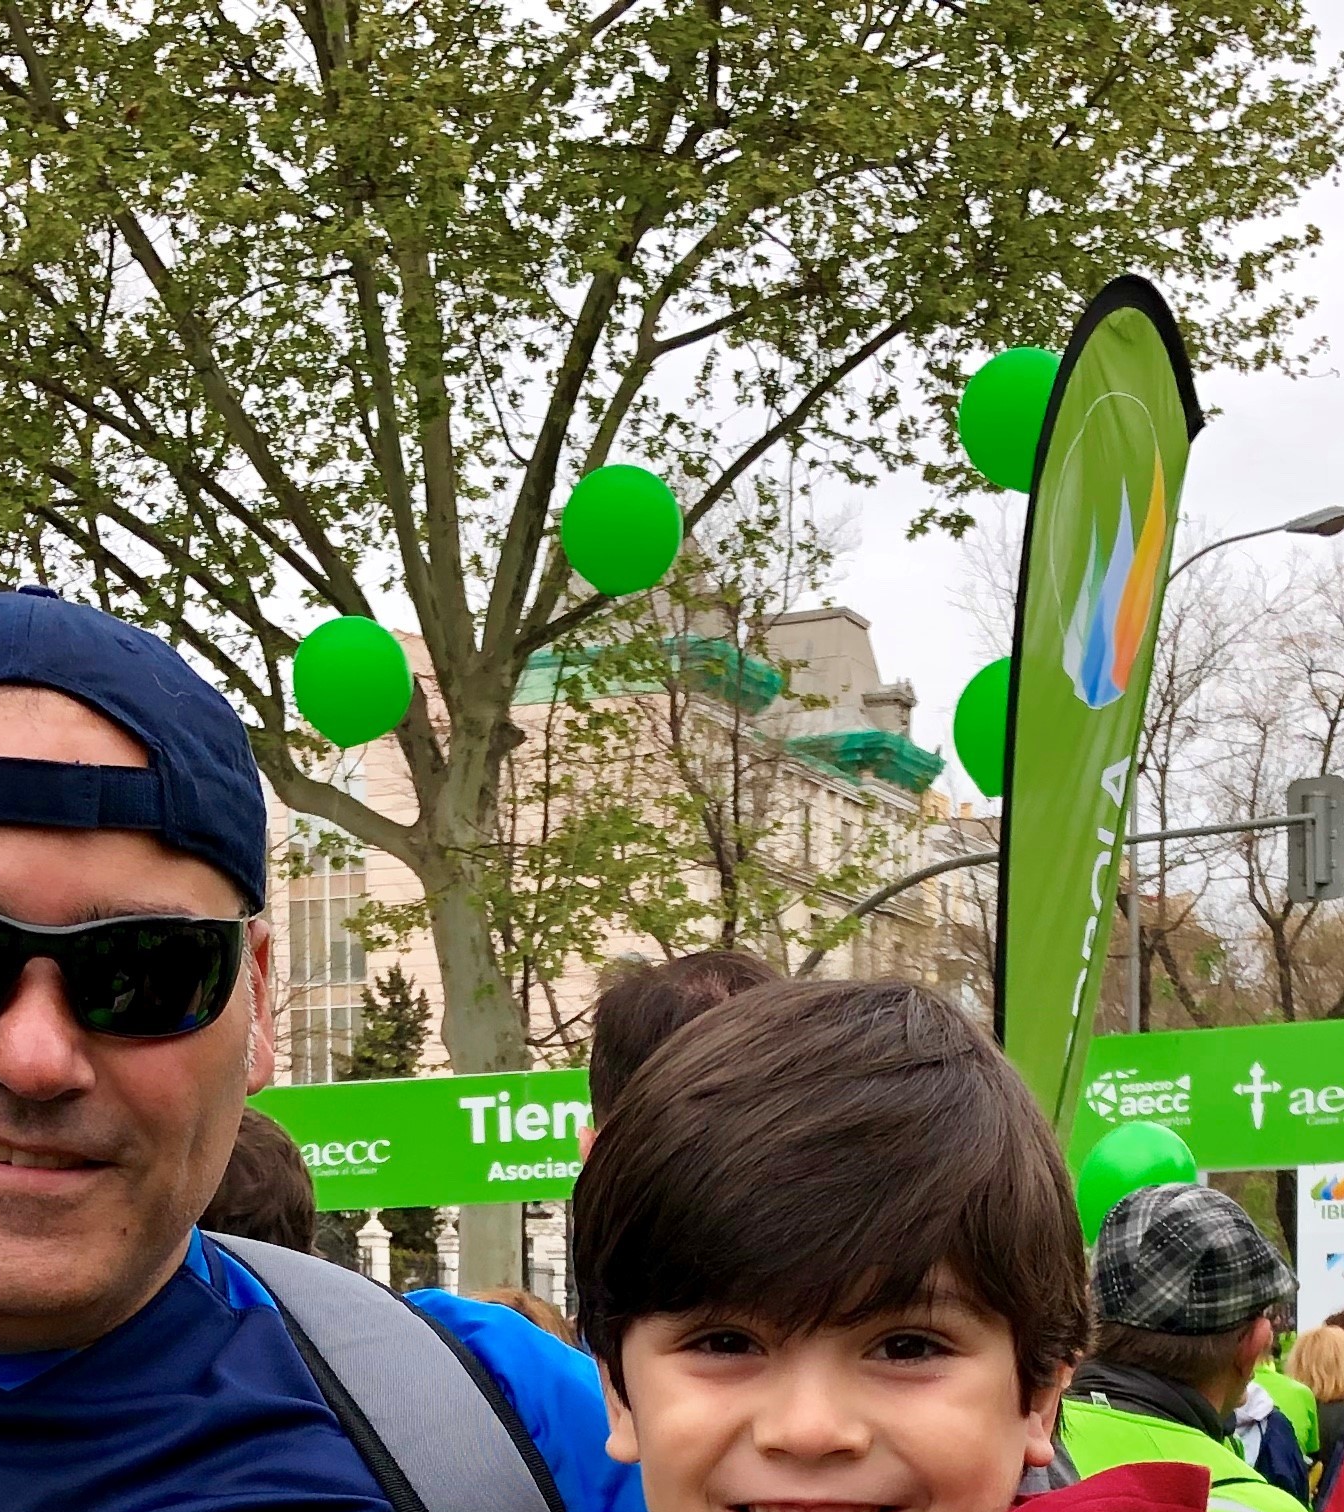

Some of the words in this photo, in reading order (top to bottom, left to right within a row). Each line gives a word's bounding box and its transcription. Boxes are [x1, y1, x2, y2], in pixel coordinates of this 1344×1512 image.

[1120, 1080, 1174, 1093] espacio
[1119, 1093, 1190, 1117] aecc
[301, 1139, 391, 1167] aecc
